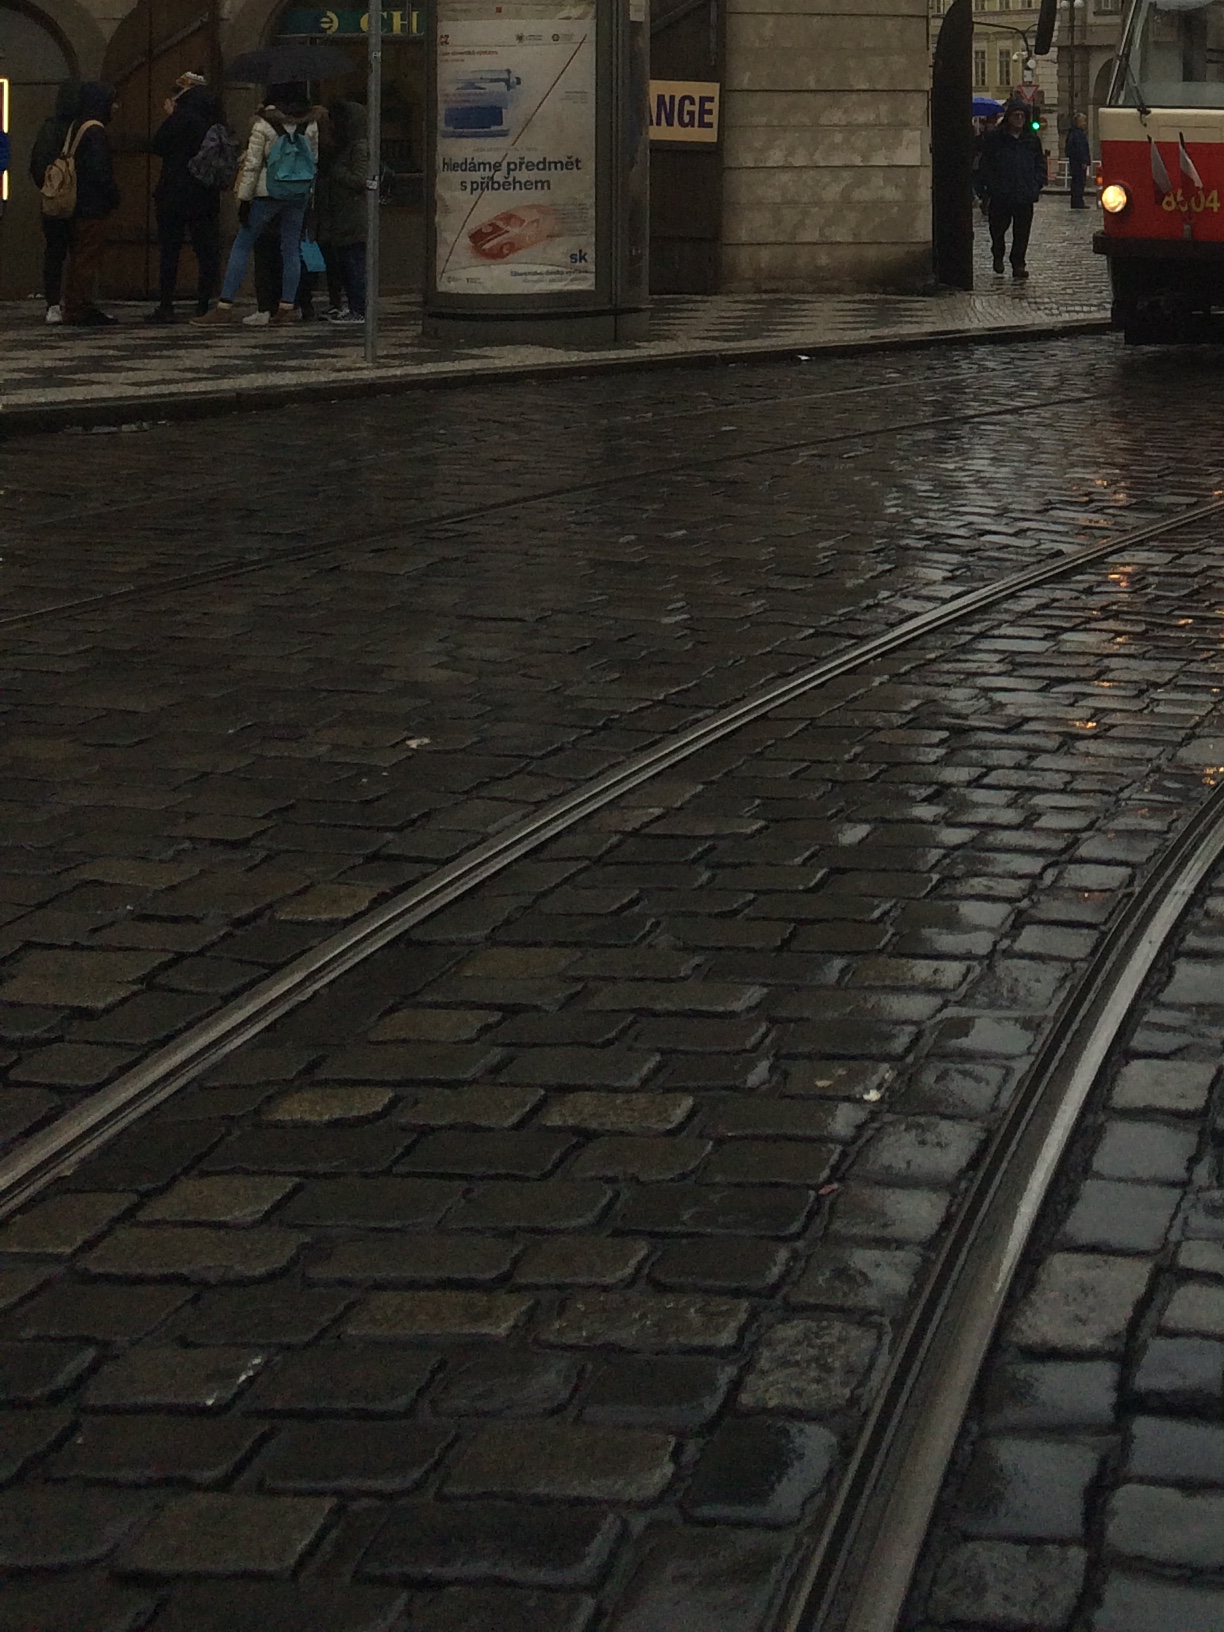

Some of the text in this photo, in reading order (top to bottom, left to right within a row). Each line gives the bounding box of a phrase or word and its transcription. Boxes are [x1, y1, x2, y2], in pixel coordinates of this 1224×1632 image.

[649, 94, 715, 128] NGE
[442, 156, 582, 175] hledáme předmět
[460, 176, 551, 195] s příběhem
[569, 249, 588, 264] sk
